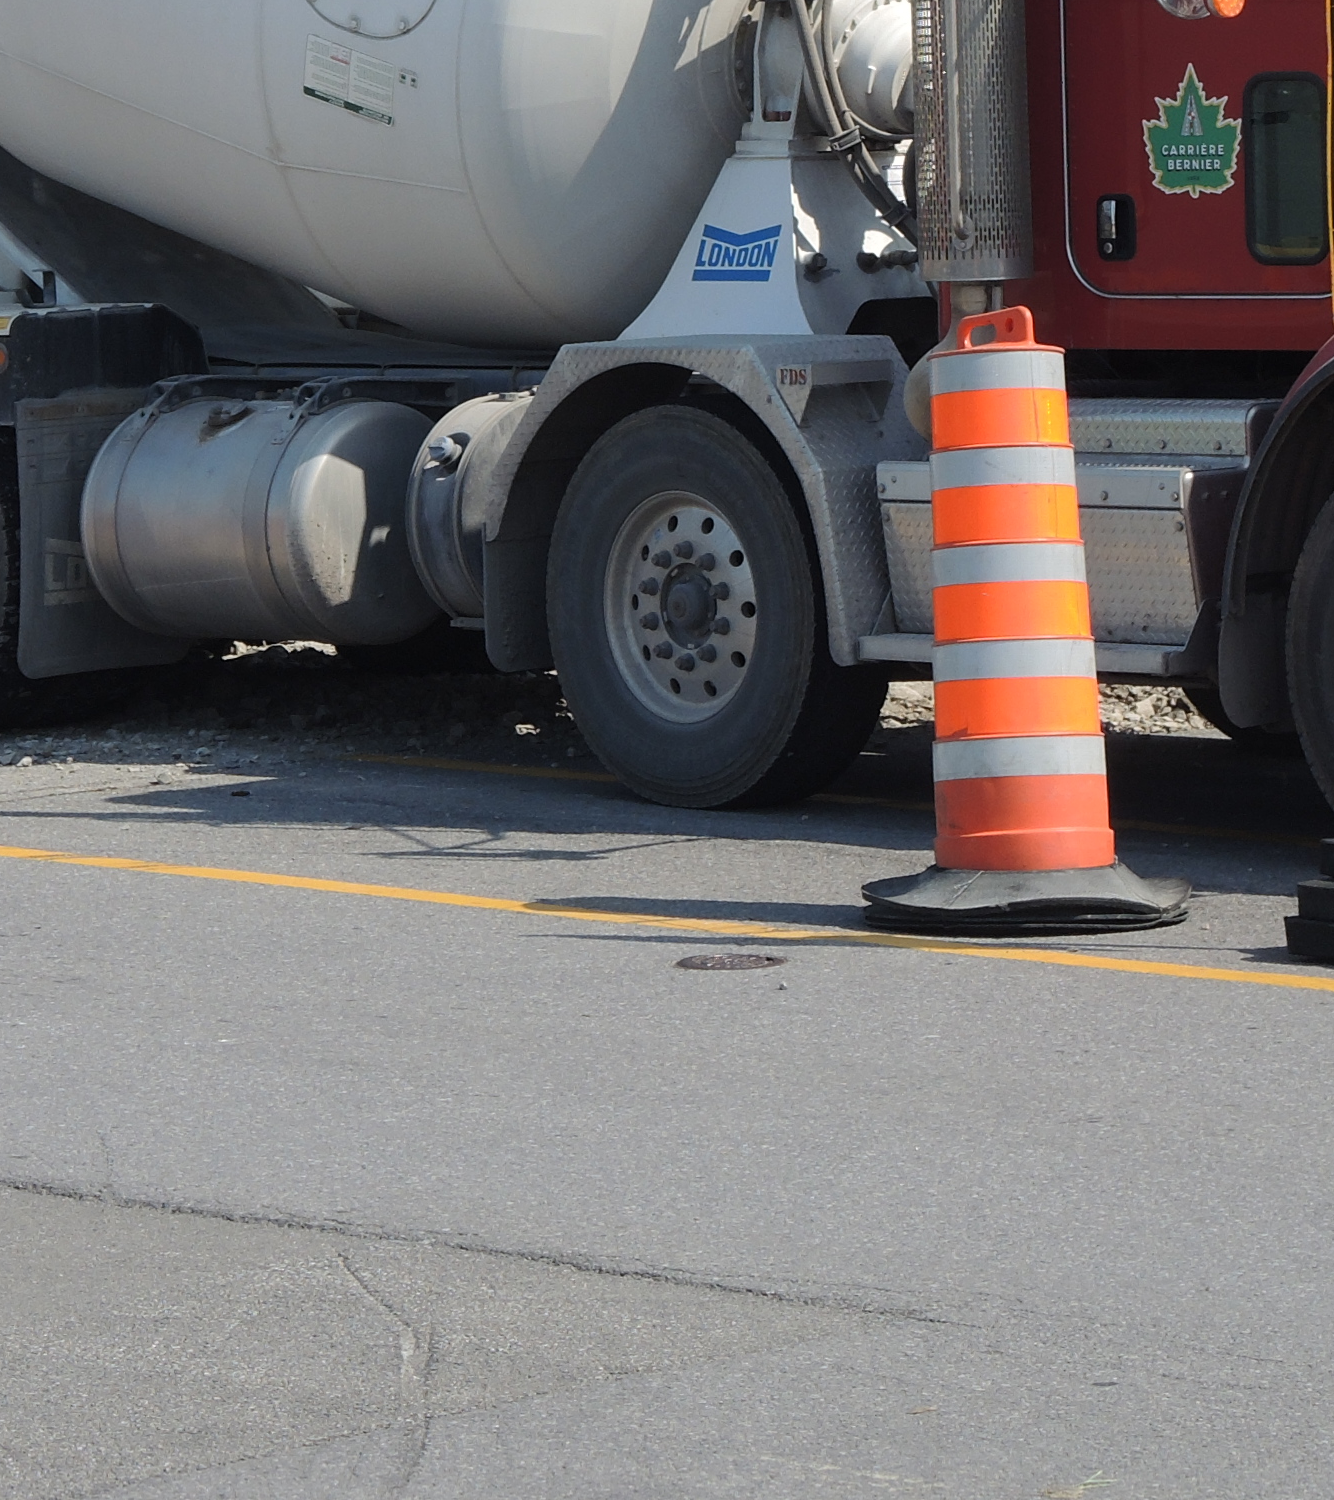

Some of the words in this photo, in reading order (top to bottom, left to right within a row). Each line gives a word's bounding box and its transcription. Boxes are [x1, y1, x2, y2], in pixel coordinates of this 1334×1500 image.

[1161, 143, 1225, 156] CARRIÈRE
[1167, 159, 1221, 171] BERNIER
[695, 239, 779, 268] LONDON
